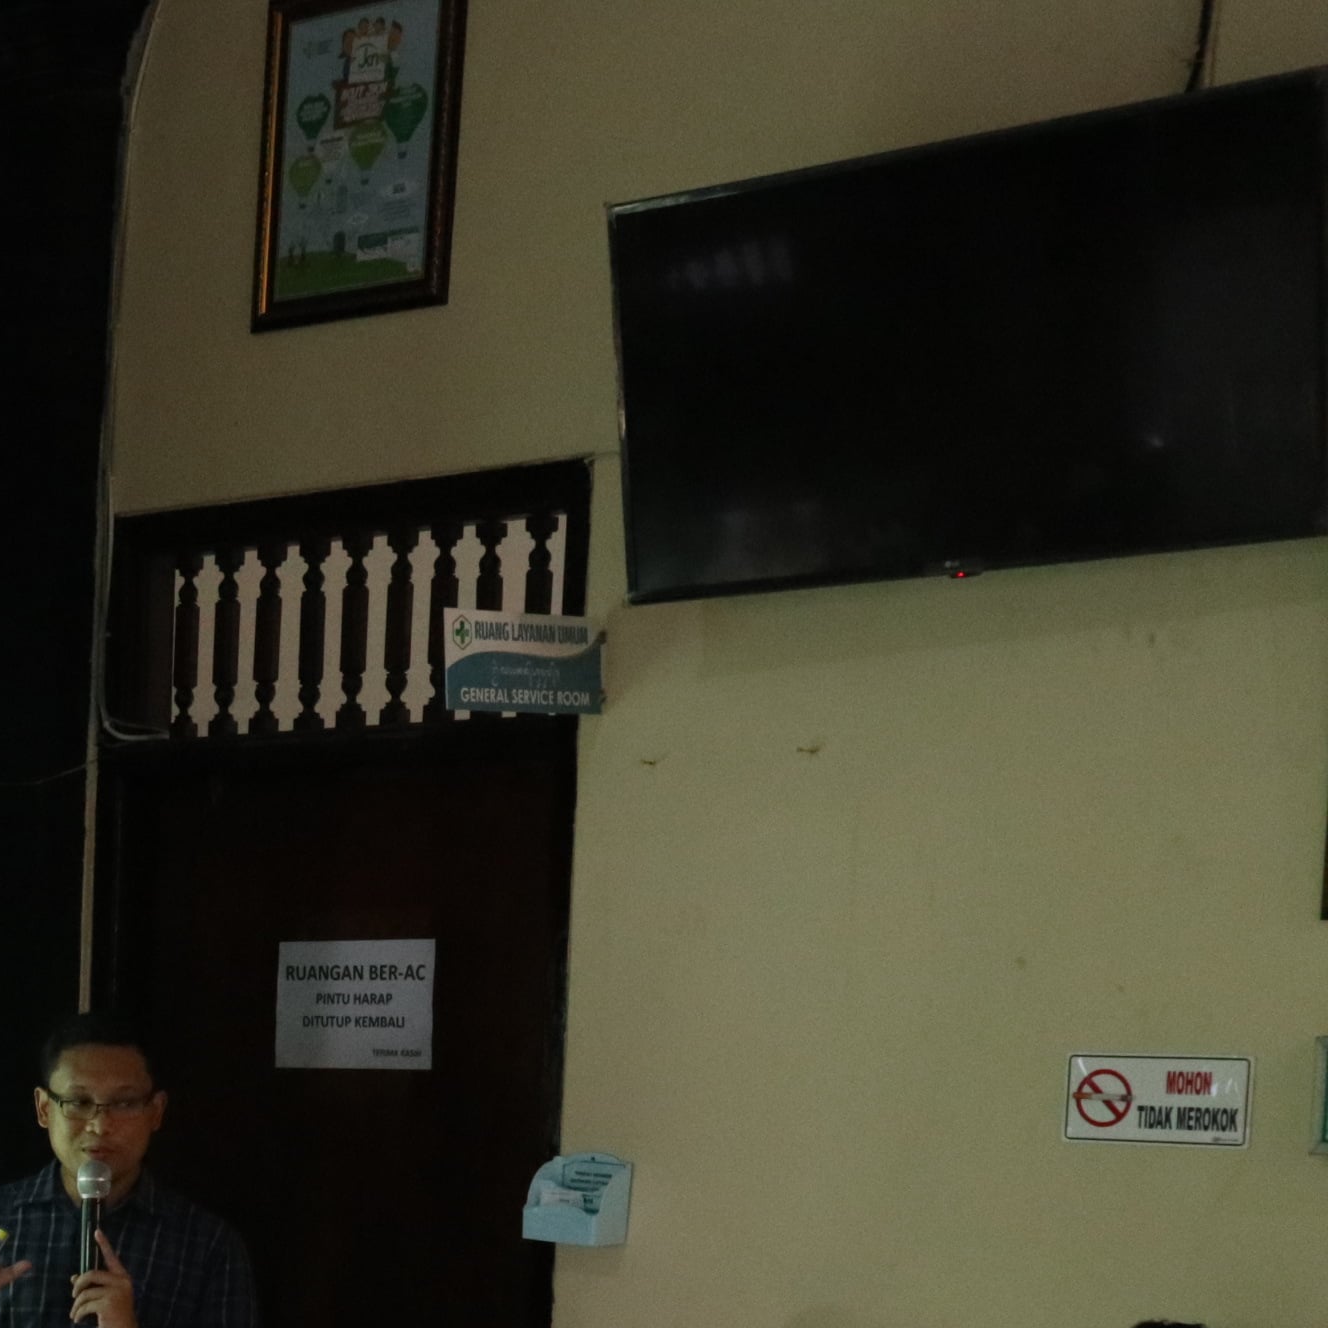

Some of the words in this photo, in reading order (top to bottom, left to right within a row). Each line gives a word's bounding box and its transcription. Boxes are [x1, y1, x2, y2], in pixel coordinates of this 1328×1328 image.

[475, 621, 510, 641] RUANG
[512, 623, 555, 644] LAYANAN
[558, 626, 588, 644] UMUM
[461, 688, 509, 703] GENERAL
[512, 689, 554, 705] SERVICE
[557, 692, 591, 706] ROOM
[286, 965, 363, 981] RUANGAN
[369, 965, 426, 980] BER-AC
[316, 993, 350, 1004] PINTU
[354, 993, 392, 1005] HARAP
[303, 1016, 351, 1028] DITUTUP
[355, 1016, 405, 1028] KEMBALI
[1166, 1071, 1212, 1095] MOHON
[1137, 1105, 1173, 1130] TIDAK
[1176, 1107, 1238, 1132] MEROKOK
